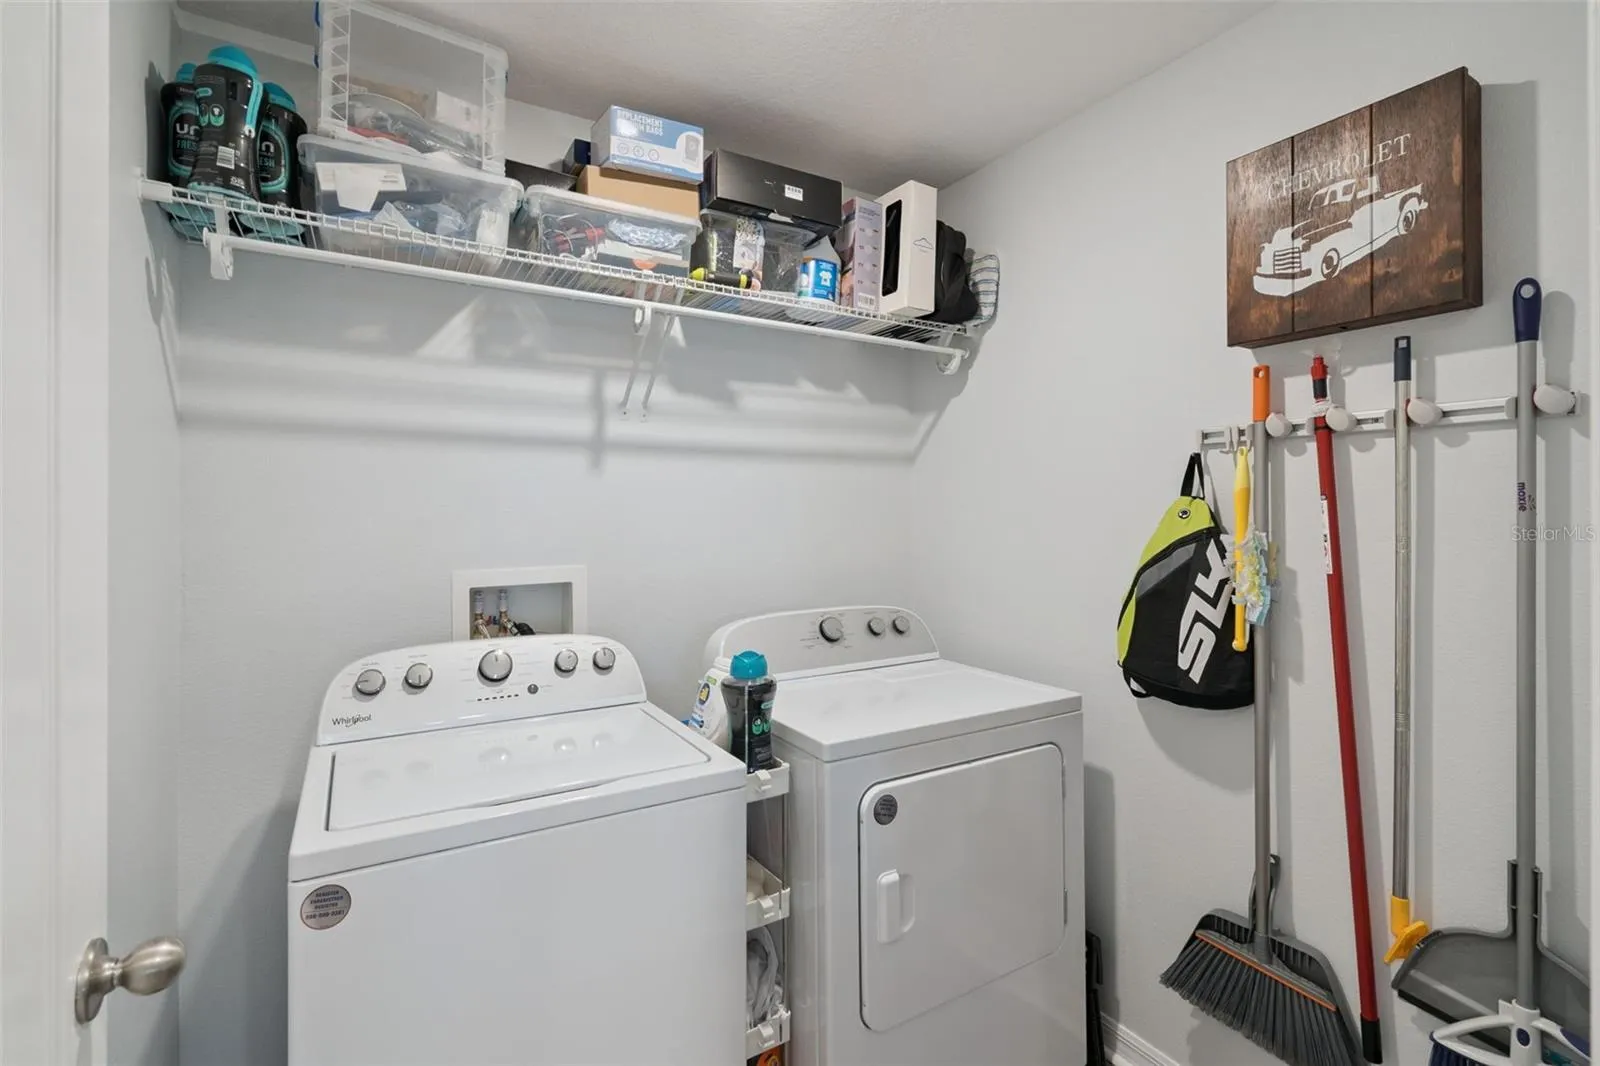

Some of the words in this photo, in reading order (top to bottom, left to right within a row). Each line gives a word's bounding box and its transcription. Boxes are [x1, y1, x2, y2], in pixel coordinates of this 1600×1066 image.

[1267, 133, 1411, 201] CHEVROLET
[1517, 482, 1527, 513] moxie
[331, 713, 372, 728] Whirlpool
